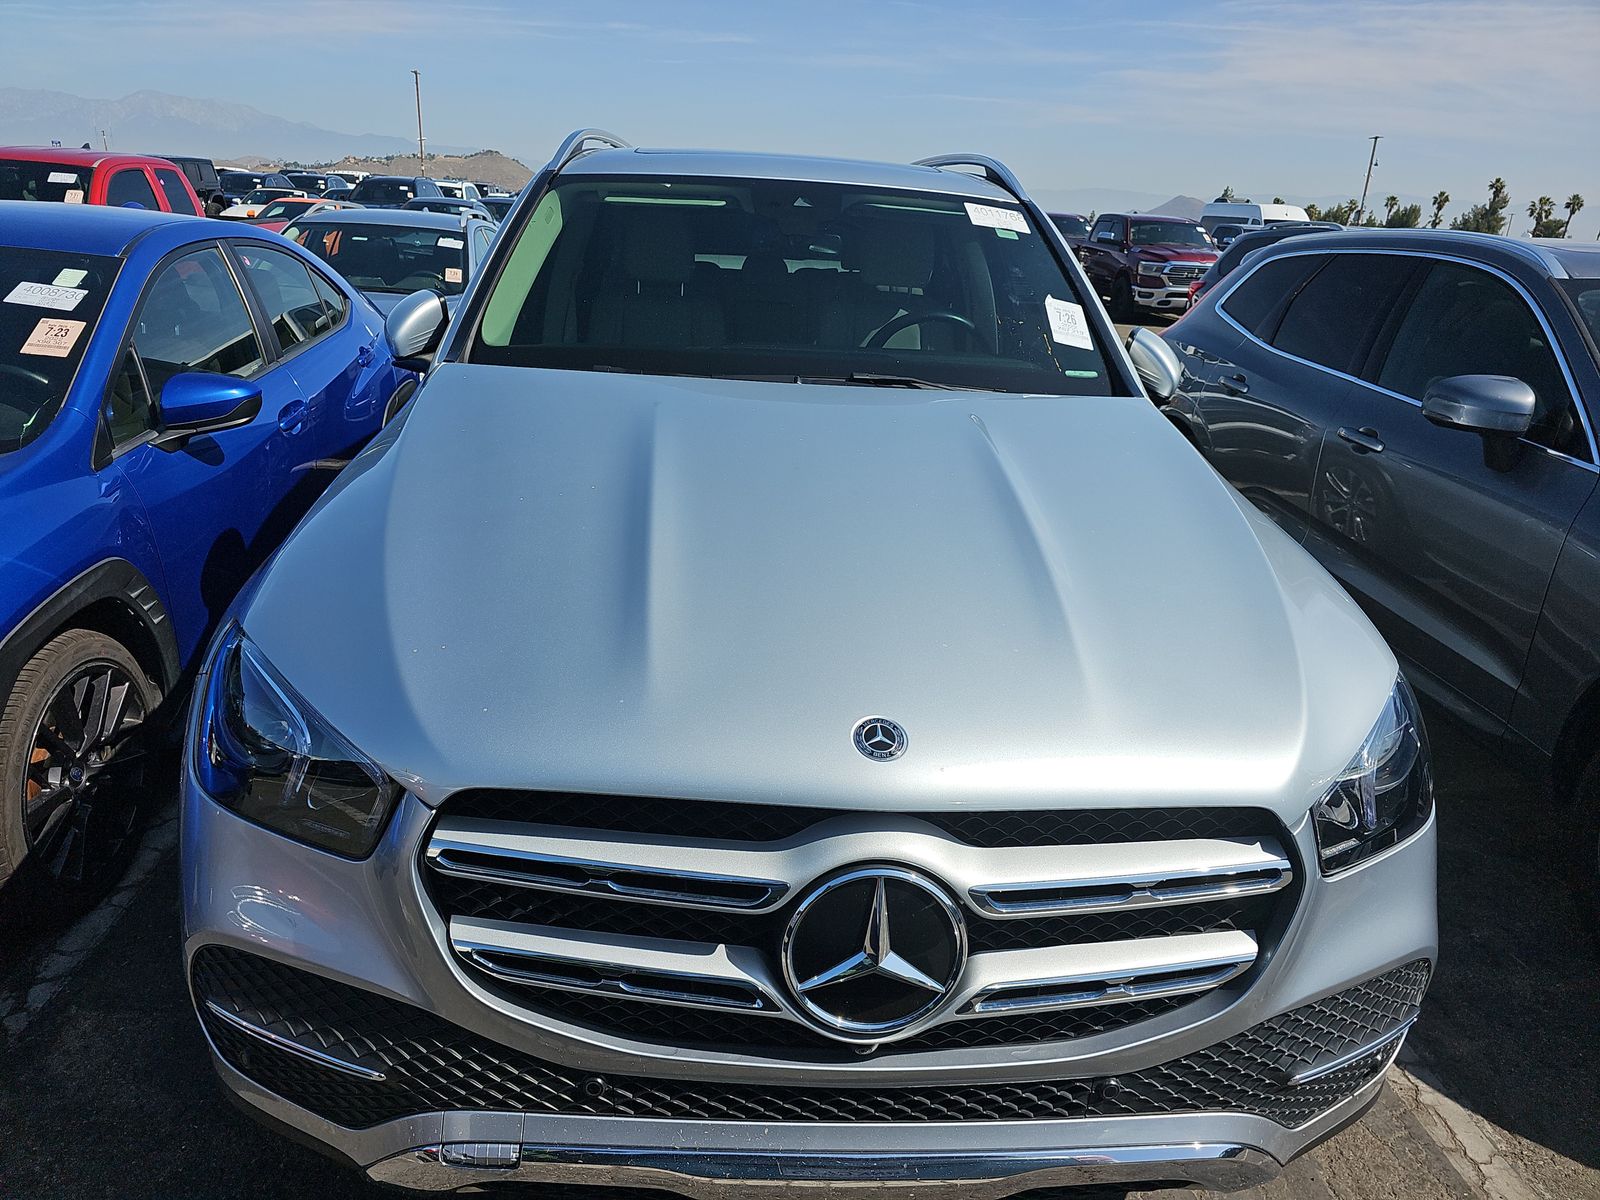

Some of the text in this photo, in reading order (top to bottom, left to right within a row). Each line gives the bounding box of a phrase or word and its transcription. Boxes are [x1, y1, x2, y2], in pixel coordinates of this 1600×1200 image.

[23, 285, 85, 301] 4008730
[1056, 310, 1077, 325] 7:26
[44, 326, 70, 338] 7:23
